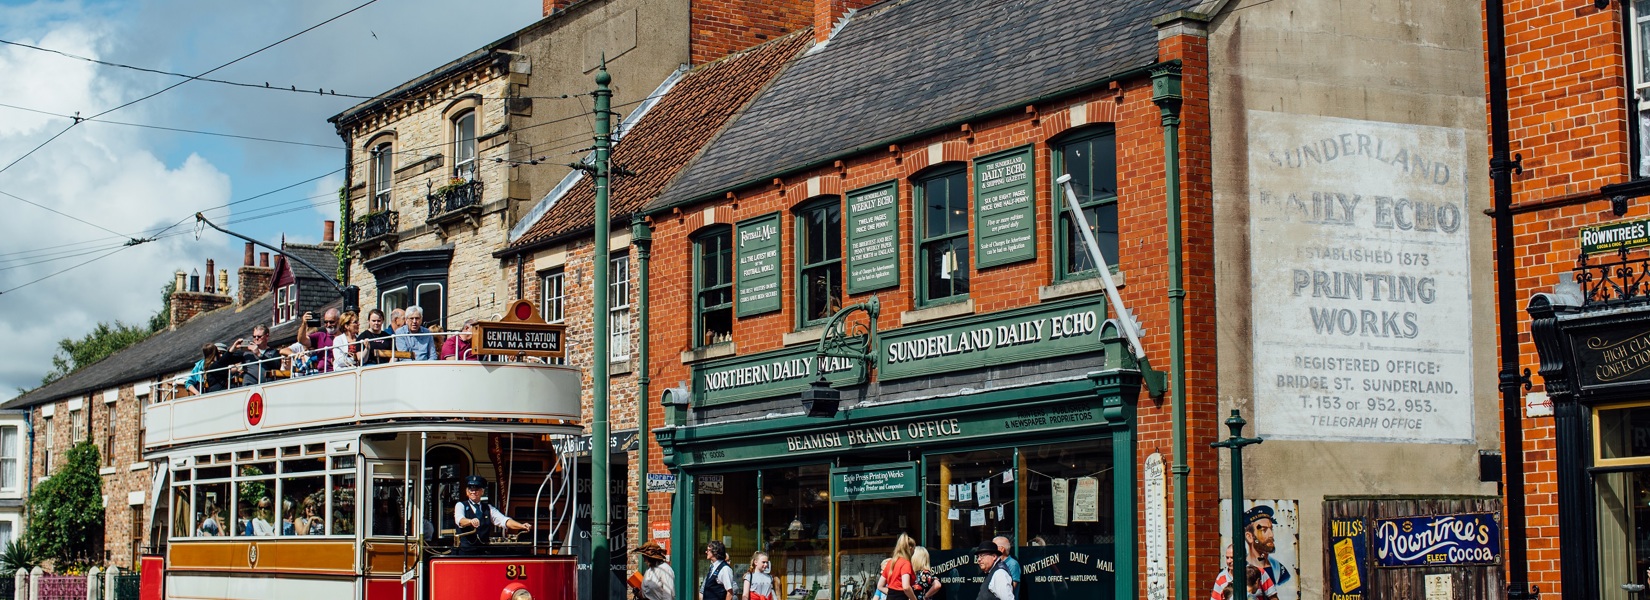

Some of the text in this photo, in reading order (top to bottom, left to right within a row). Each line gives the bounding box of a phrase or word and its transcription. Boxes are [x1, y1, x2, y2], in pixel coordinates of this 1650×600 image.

[995, 157, 1022, 168] SUNDERLAND
[1268, 133, 1450, 186] SUNDERLAND
[982, 163, 1026, 181] DAILY ECHO
[986, 178, 1005, 187] SHIPPING
[1006, 173, 1026, 182] GAZETTE
[864, 190, 887, 200] SUNDERLAND
[998, 192, 1011, 200] EIGHT
[851, 195, 893, 212] WEEKLY ECHO
[858, 213, 886, 225] TWELVE PAGES
[1375, 195, 1462, 234] ECHO
[876, 220, 889, 228] PENNY
[1583, 223, 1645, 246] ROWNTREE'S
[753, 252, 766, 261] LATEST
[767, 250, 777, 258] NEWS
[1296, 247, 1430, 267] ESTABLISHED 1873
[743, 264, 774, 277] FOOTBALL WORLD
[1293, 269, 1436, 304] PRINTING
[1309, 306, 1419, 339] WORKS
[487, 331, 557, 342] CENTRAL STATION
[889, 311, 1097, 363] SUNDERLAND DAILY ECHO
[1602, 345, 1628, 363] HIGH
[1295, 356, 1441, 375] REGISTERED OFFICE:
[1596, 350, 1650, 377] CONFECTIO
[704, 355, 854, 391] NORTHERN DAILY MAIL
[1276, 374, 1458, 395] BRIDGE ST. SUNDERLAND.
[249, 401, 260, 417] 31
[1052, 403, 1091, 414] PUBLISHERS
[1346, 400, 1360, 410] or
[1011, 417, 1046, 428] NEWSPAPER
[1049, 412, 1093, 424] PROPRIETORS
[1311, 415, 1423, 429] TELEGRAPH OFFICE
[786, 418, 961, 451] BEAMISH BRANCH OFFICE
[710, 450, 725, 458] GOODS
[855, 473, 868, 481] Press
[869, 472, 888, 482] Printing
[888, 470, 904, 478] Works
[1378, 516, 1489, 561] Rowntree's
[930, 555, 970, 576] SUNDERLAND
[1023, 551, 1114, 575] NORTHERN DAILY MAIL
[1427, 554, 1447, 562] ELECT
[507, 564, 527, 578] 31
[1034, 575, 1047, 583] HEAD
[1070, 574, 1098, 582] HARTLEPOOL
